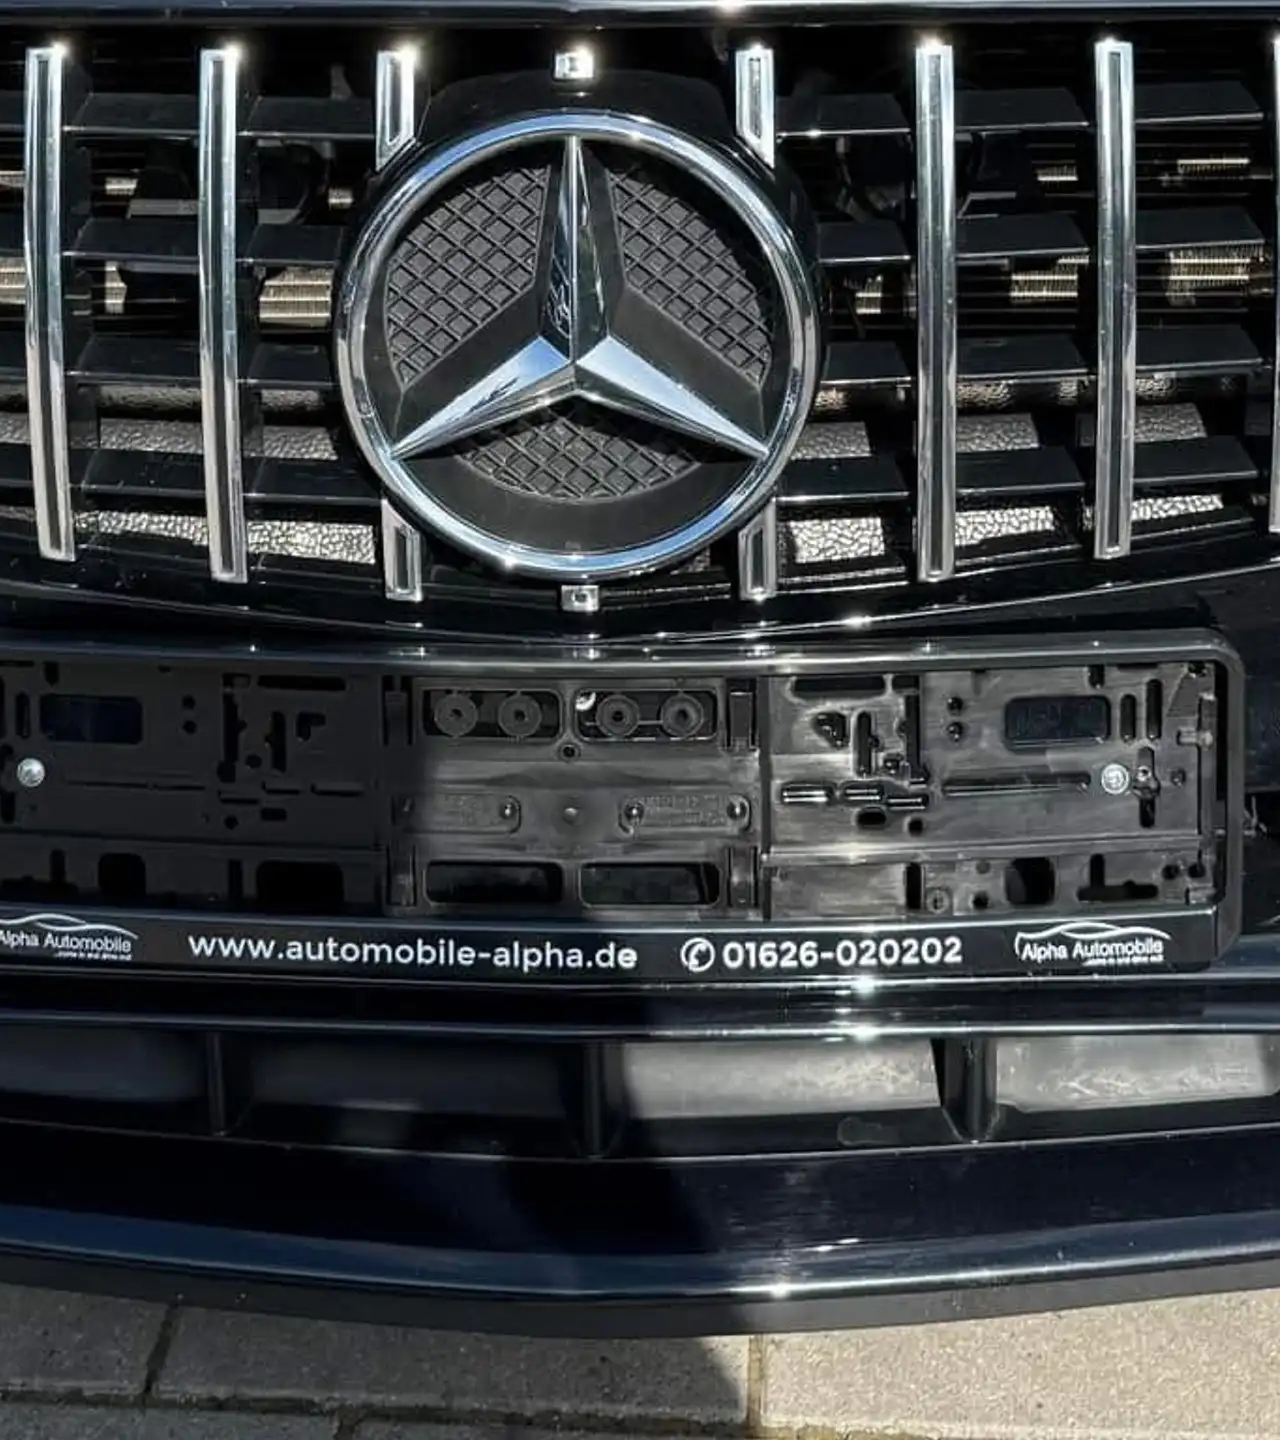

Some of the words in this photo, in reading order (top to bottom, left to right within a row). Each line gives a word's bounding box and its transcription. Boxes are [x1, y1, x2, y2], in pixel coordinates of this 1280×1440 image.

[43, 933, 131, 952] Automobile
[188, 935, 638, 972] www.automobile-alpha.de
[723, 936, 963, 968] 01626-020202
[1021, 943, 1068, 963] Alpha
[1073, 938, 1163, 958] Automobile
